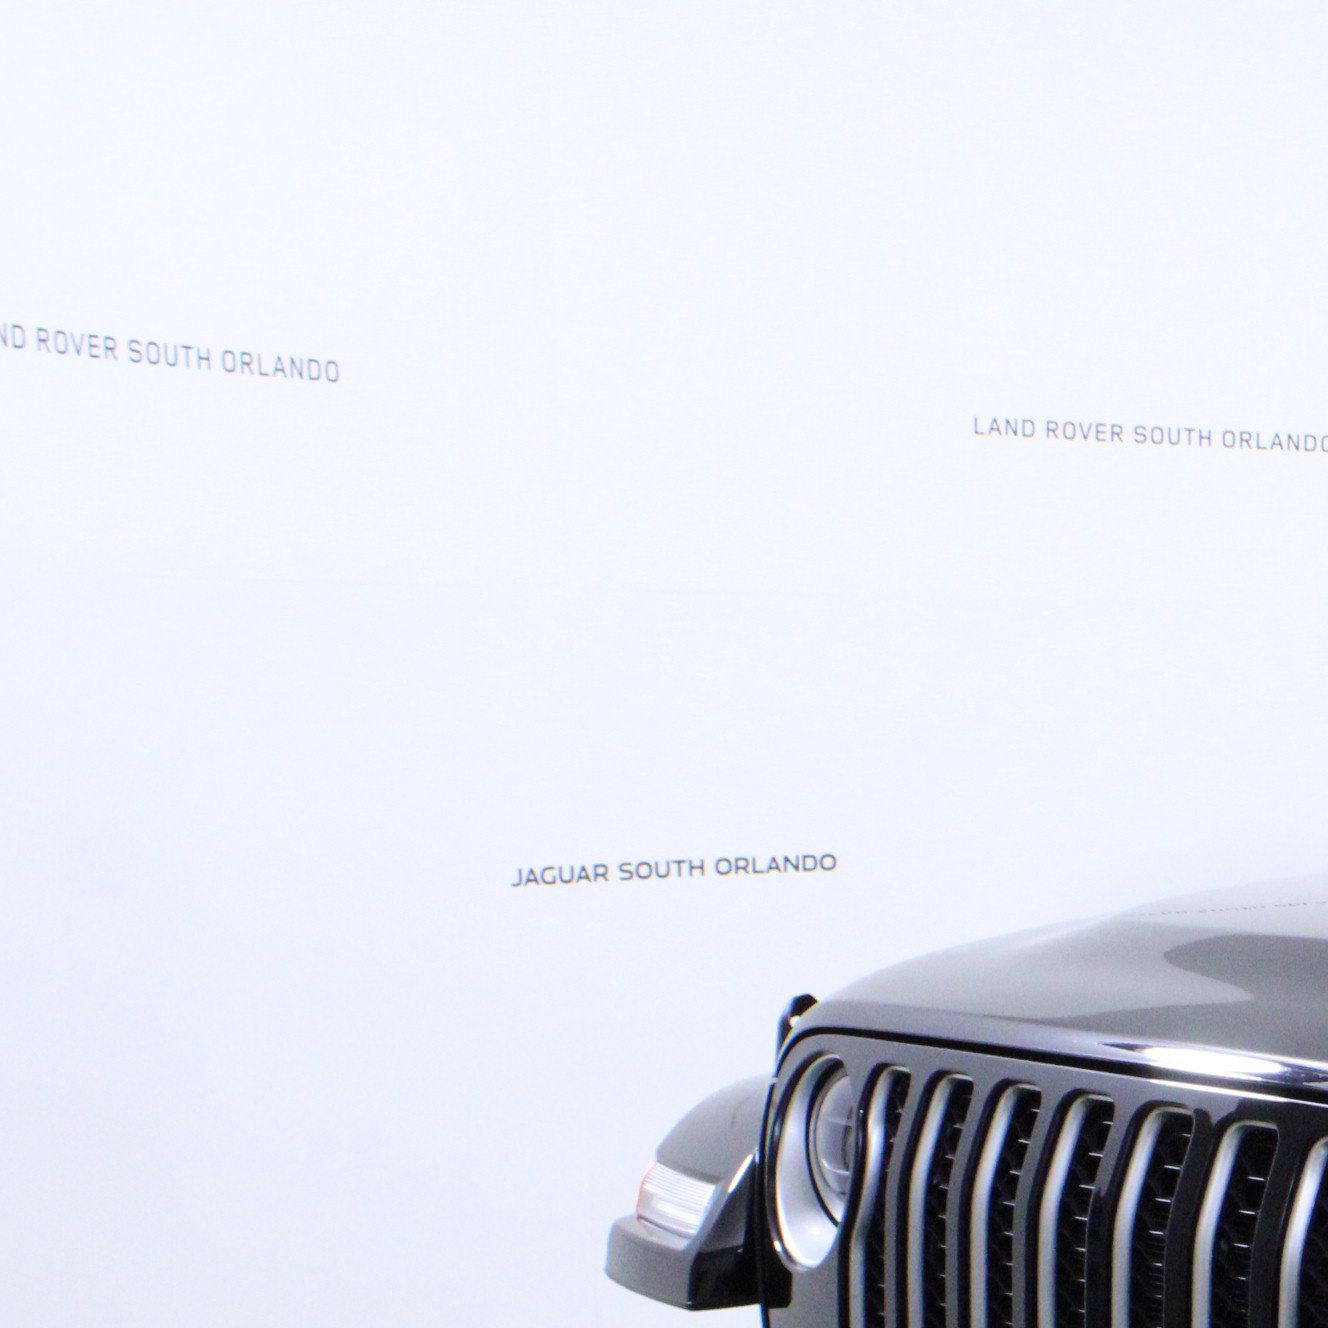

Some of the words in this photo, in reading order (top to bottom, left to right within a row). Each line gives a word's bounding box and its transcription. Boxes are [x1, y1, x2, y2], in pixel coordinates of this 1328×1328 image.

[36, 327, 117, 360] ROVER
[128, 339, 211, 370] SOUTH
[222, 349, 340, 383] ORLANDO
[974, 417, 1035, 438] LAND
[1046, 420, 1124, 442] ROVER
[1134, 425, 1212, 447] SOUTH
[511, 863, 609, 887] JAGUAR
[618, 859, 705, 881] SOUTH
[715, 853, 837, 876] ORLANDO
